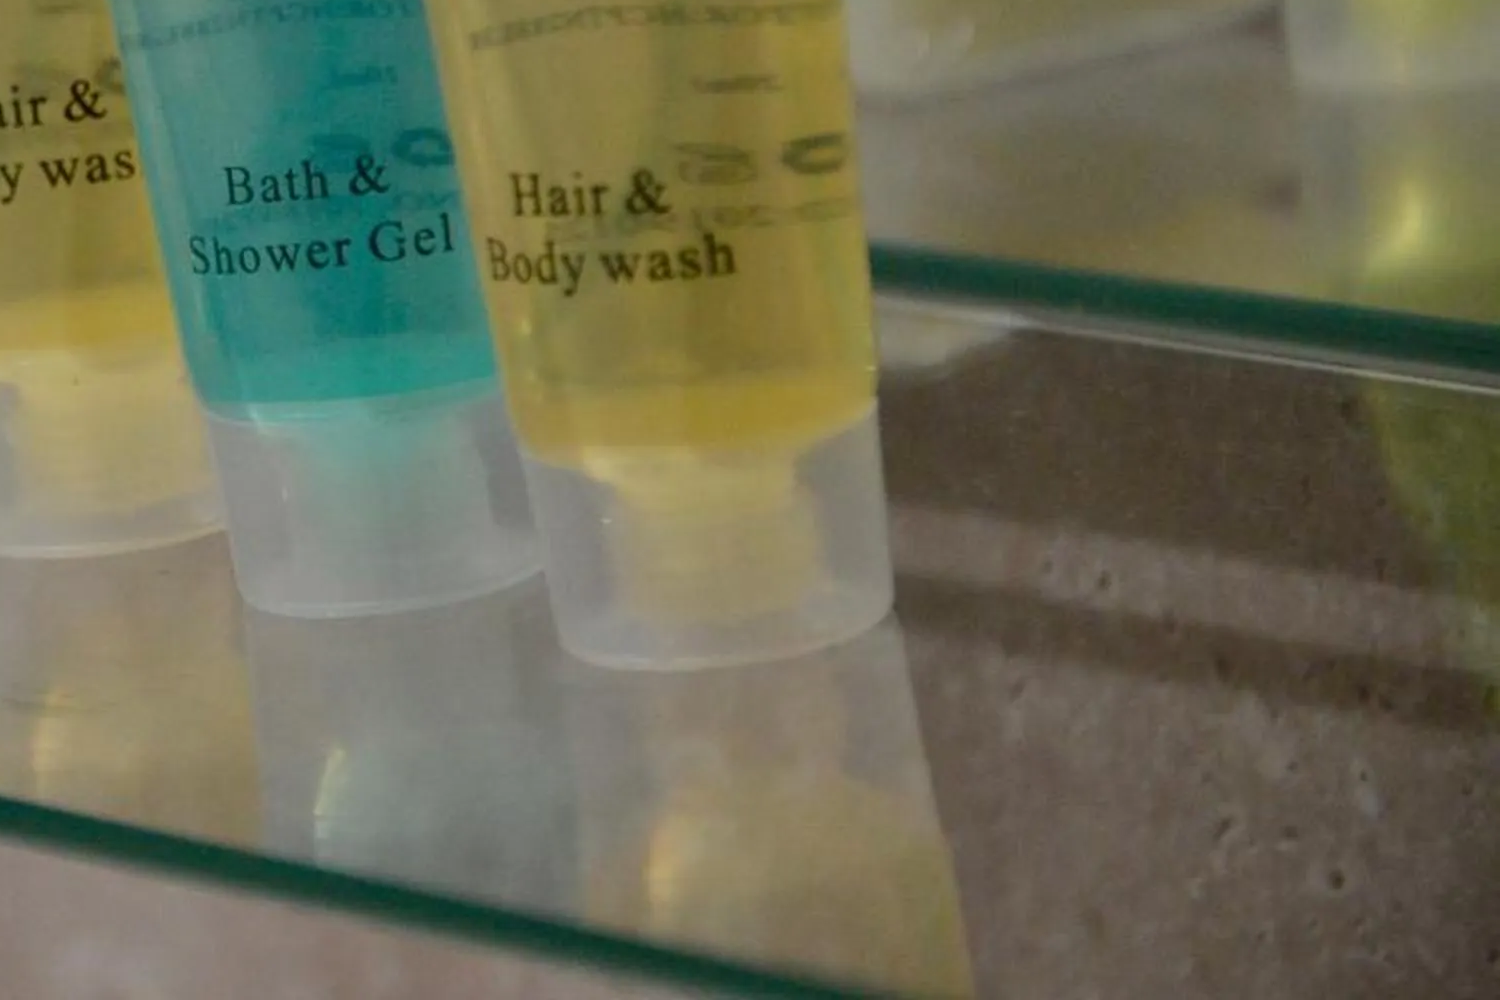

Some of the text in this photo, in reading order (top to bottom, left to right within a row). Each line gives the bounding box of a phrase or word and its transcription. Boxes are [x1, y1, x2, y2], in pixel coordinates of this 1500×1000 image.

[63, 79, 108, 123] &
[39, 149, 136, 188] was
[224, 153, 391, 206] Bath &
[509, 167, 673, 217] Hair &
[189, 211, 455, 276] Shower Gel
[486, 232, 737, 297] Body wash
